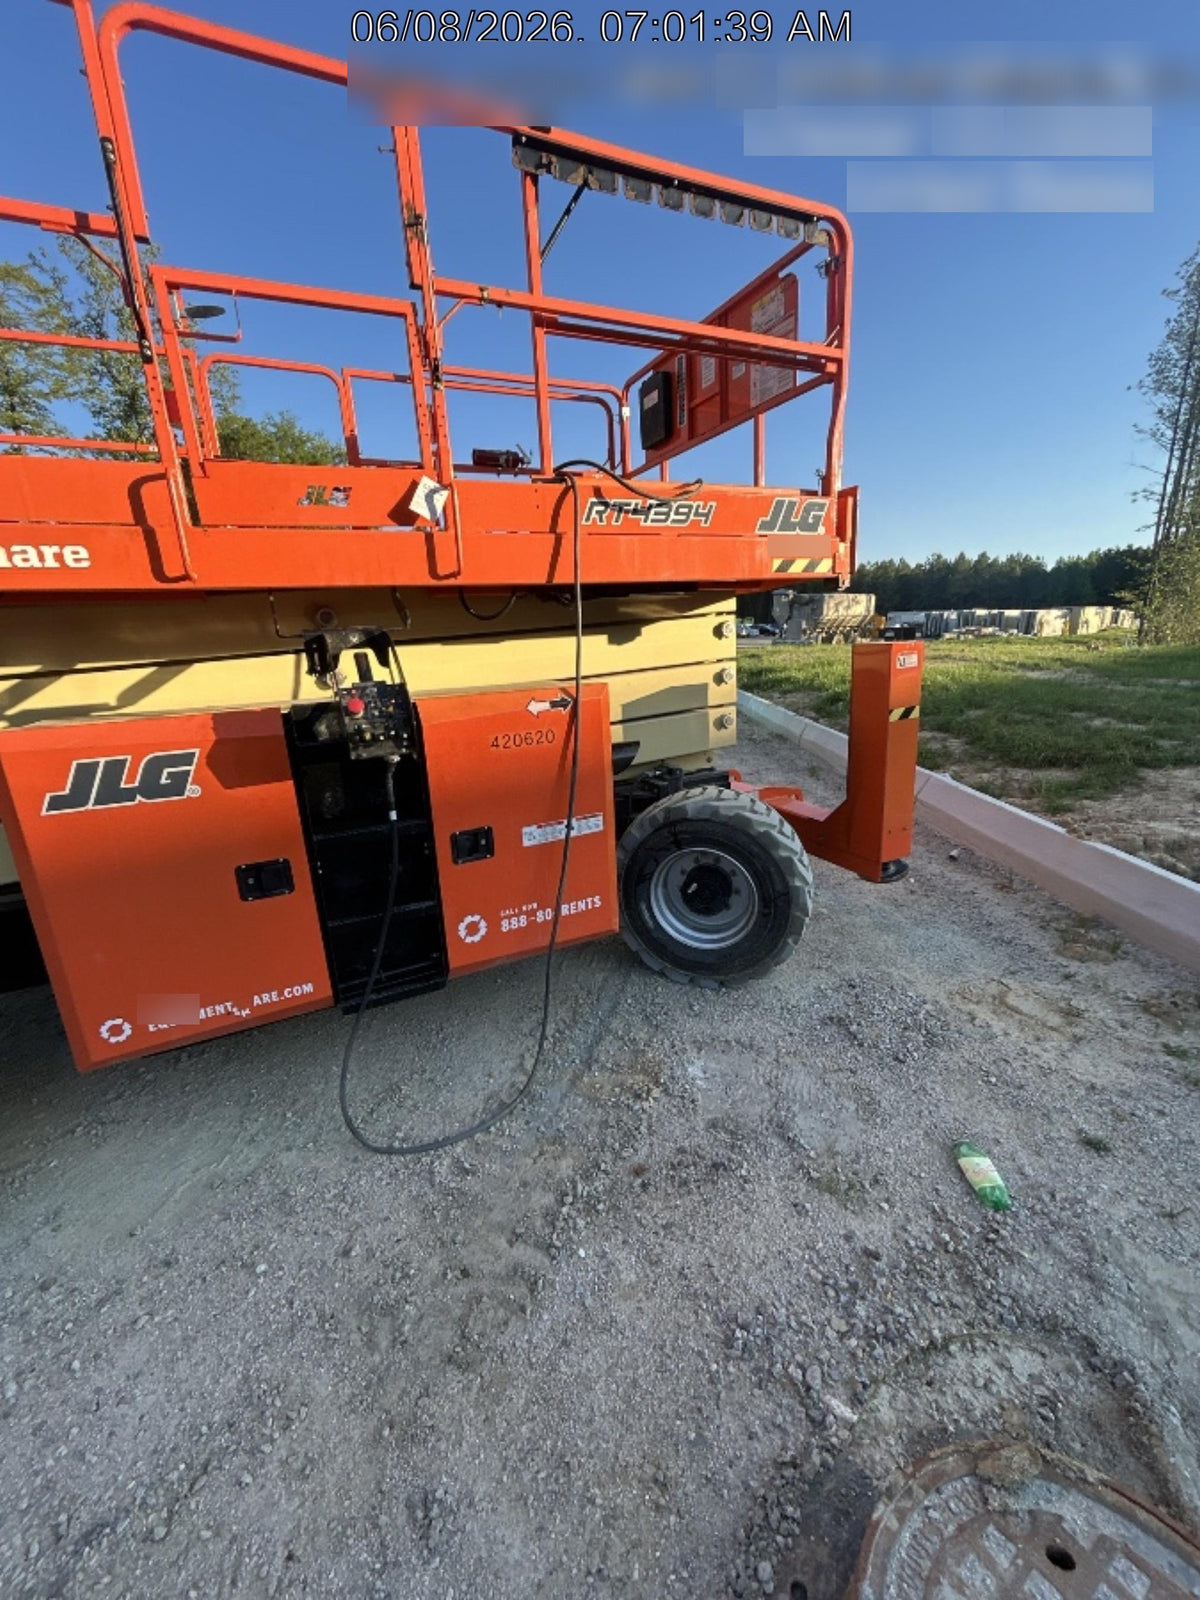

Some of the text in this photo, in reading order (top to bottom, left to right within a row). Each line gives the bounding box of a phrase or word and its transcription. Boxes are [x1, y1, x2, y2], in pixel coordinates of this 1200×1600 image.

[756, 497, 828, 534] JLG
[490, 728, 556, 750] 420620
[40, 748, 201, 816] JLG
